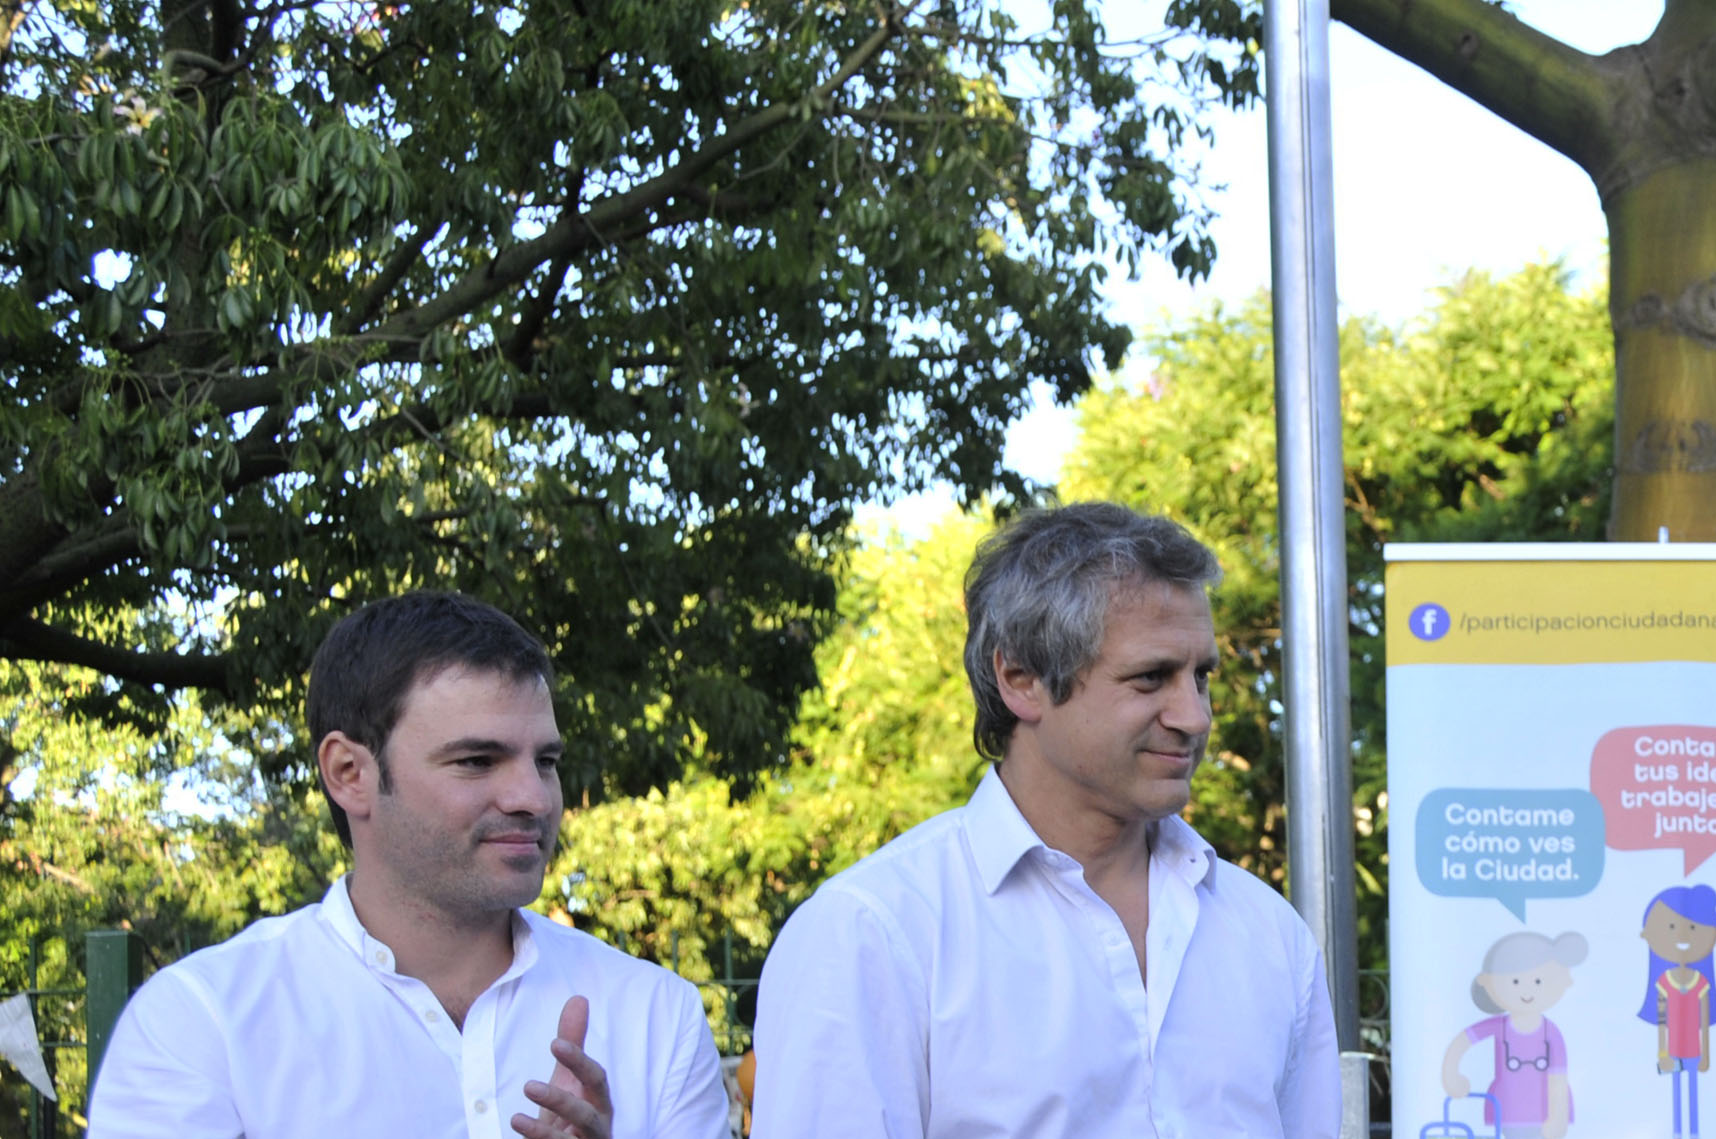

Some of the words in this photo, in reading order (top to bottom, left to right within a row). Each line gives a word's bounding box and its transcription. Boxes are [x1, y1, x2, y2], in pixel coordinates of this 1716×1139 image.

[1634, 764, 1679, 783] tus
[1445, 802, 1576, 827] Contame
[1445, 830, 1521, 853] cómo
[1528, 836, 1576, 854] ves
[1442, 857, 1467, 880] la
[1475, 857, 1580, 881] Ciudad.
